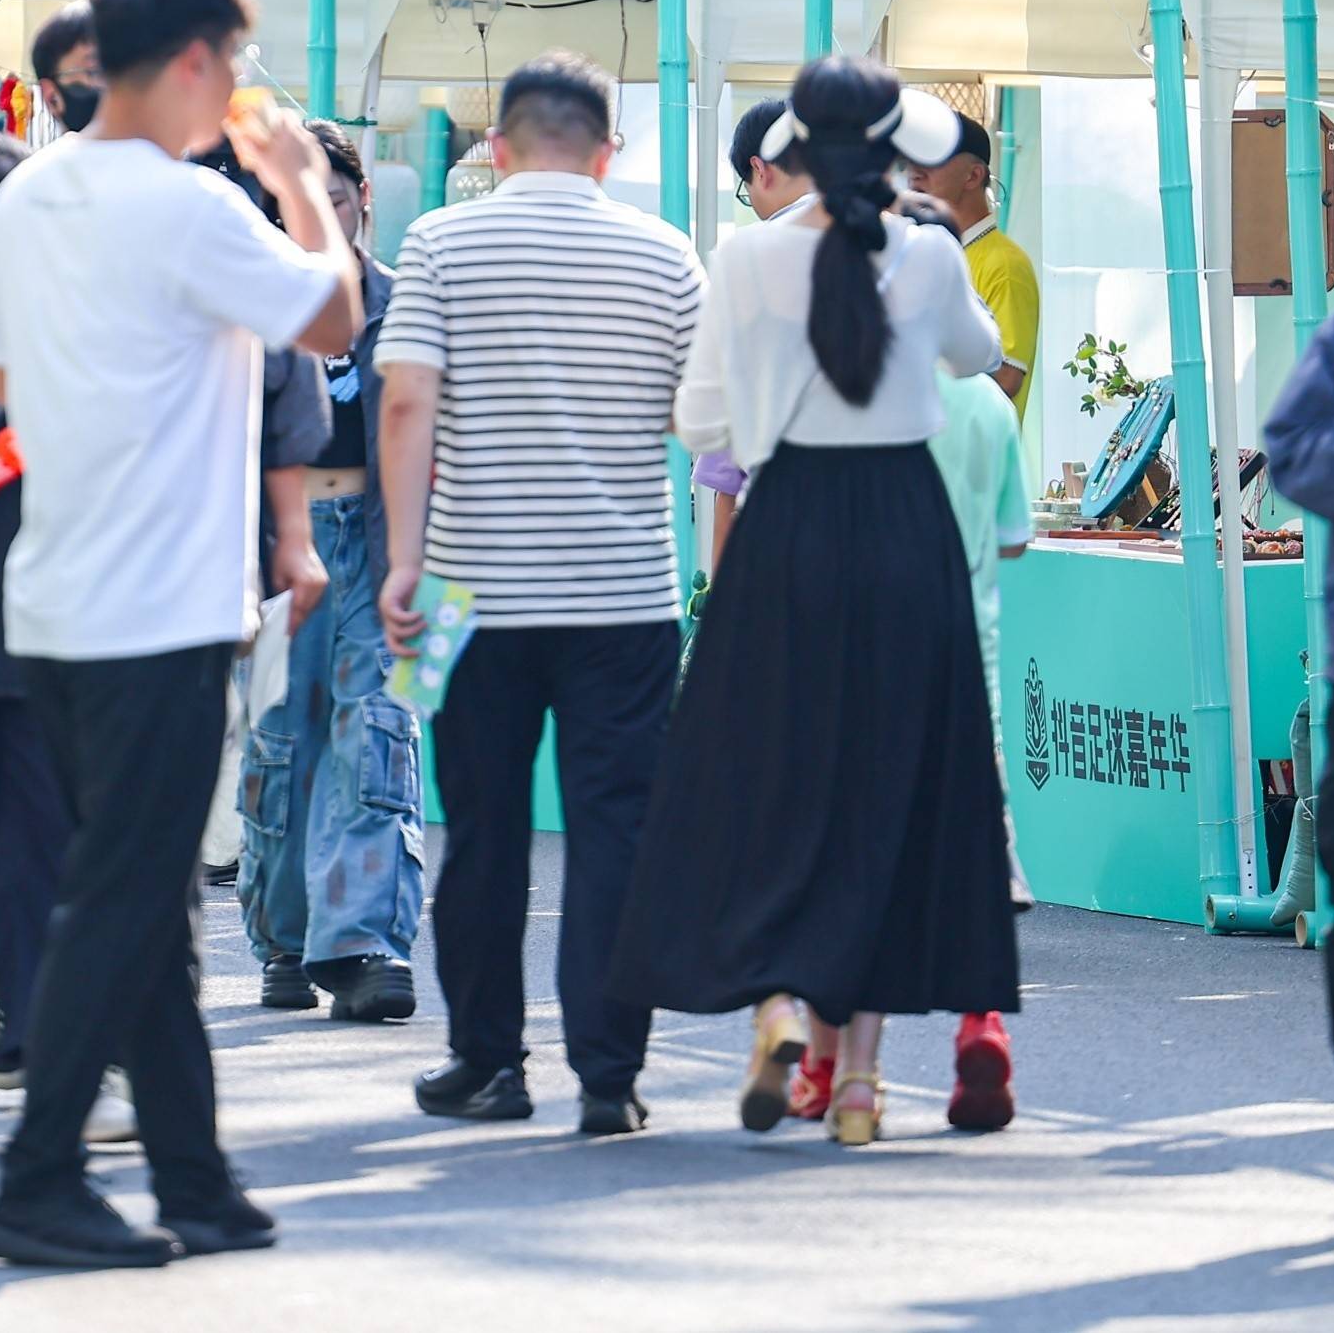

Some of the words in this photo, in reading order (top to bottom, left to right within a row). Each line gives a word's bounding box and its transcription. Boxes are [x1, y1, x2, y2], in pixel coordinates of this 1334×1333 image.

[1051, 696, 1191, 792] 抖音足球嘉年华
